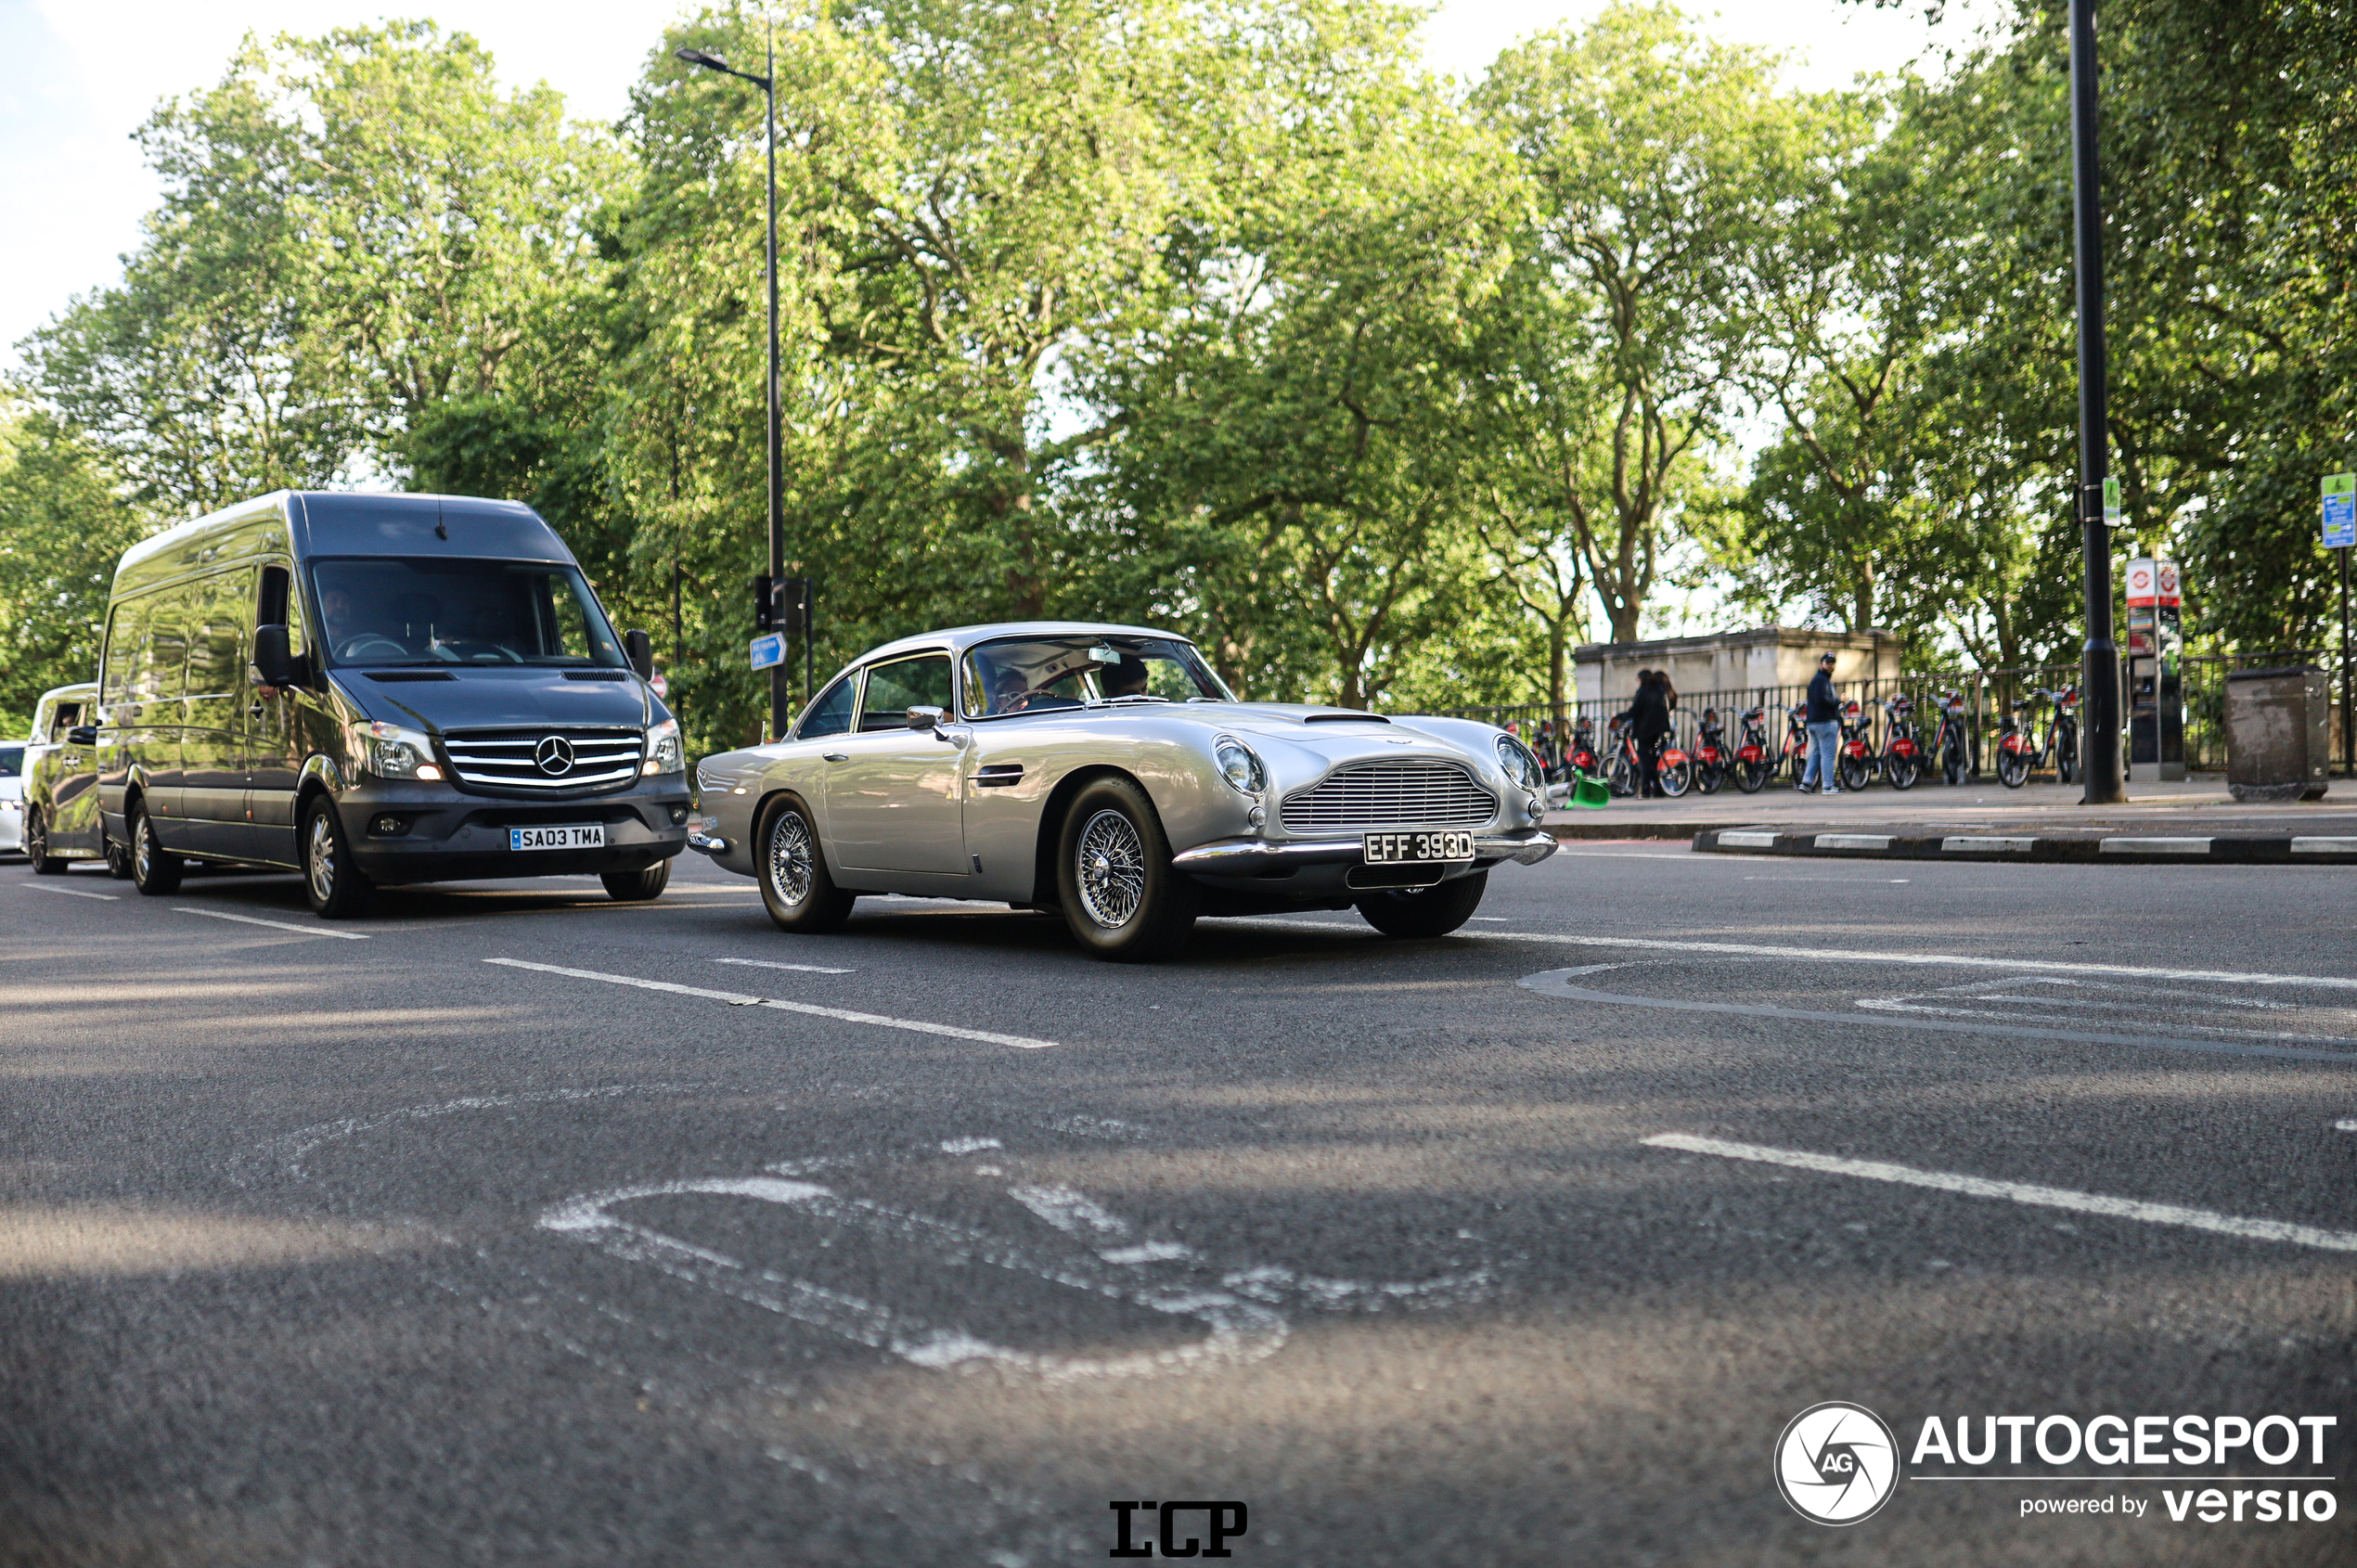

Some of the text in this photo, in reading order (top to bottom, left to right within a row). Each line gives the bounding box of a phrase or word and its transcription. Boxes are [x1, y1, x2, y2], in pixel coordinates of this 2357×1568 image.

[522, 829, 601, 846] SA03 TMA
[1367, 833, 1472, 860] EFF 393D
